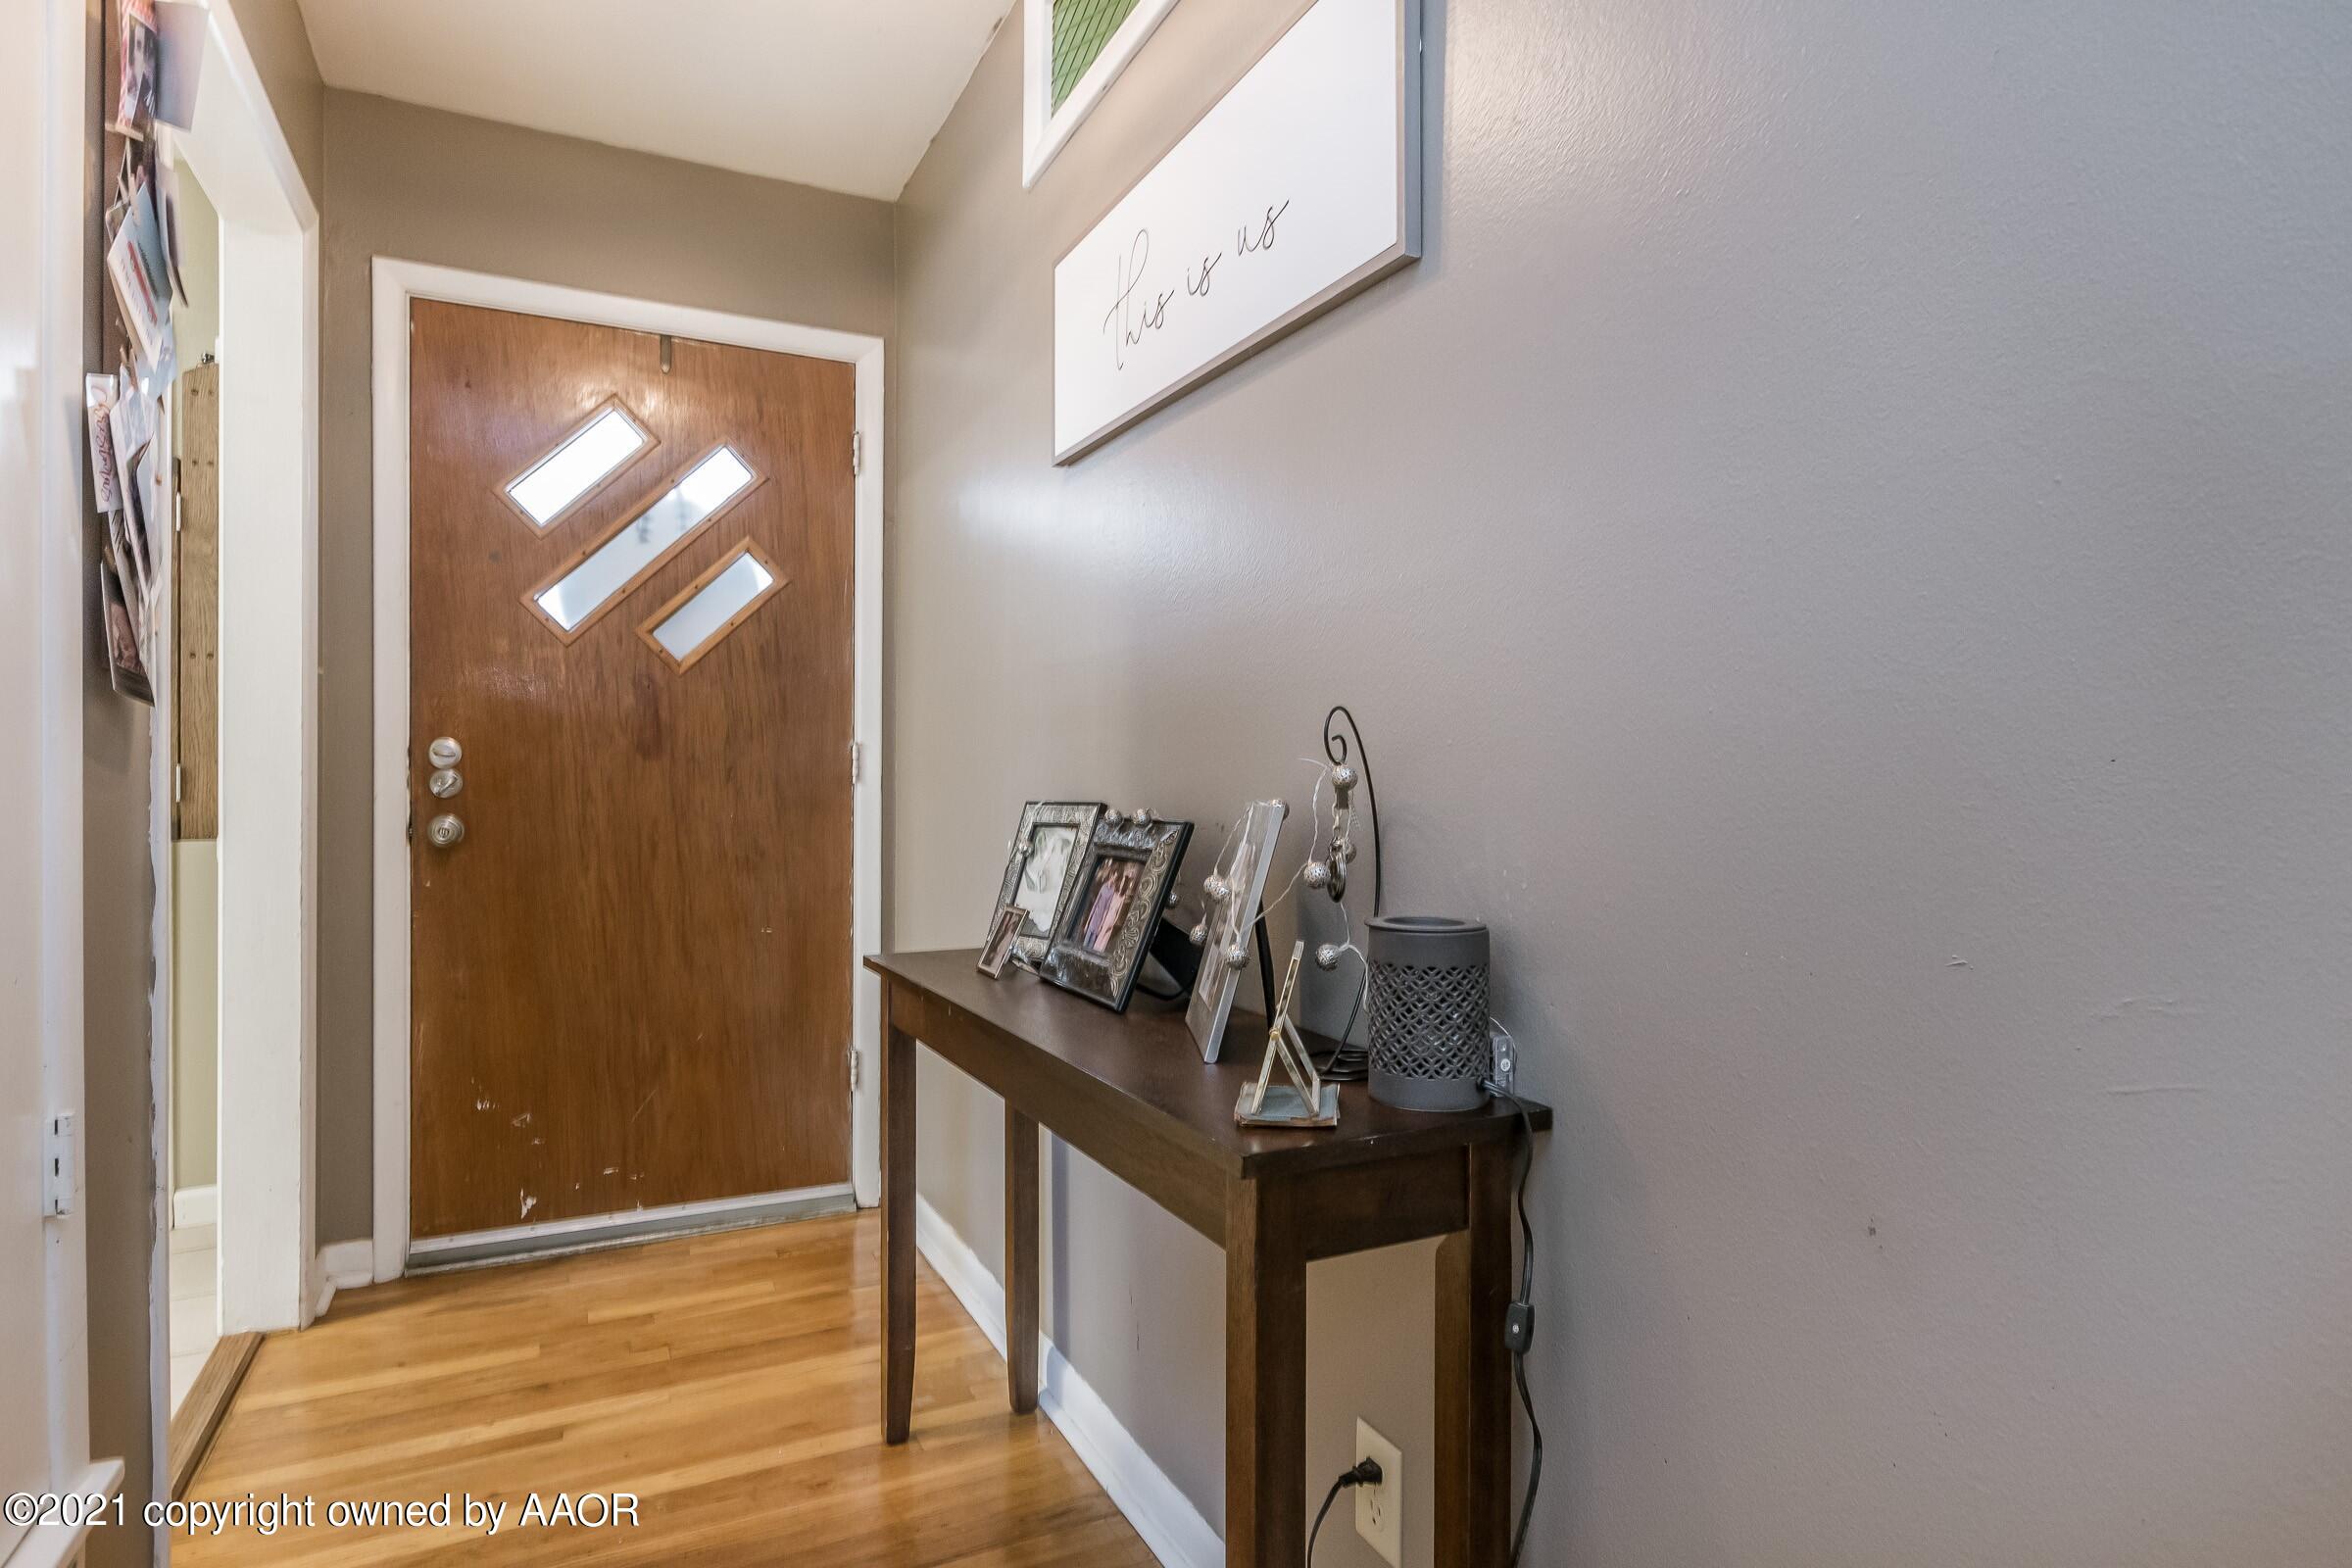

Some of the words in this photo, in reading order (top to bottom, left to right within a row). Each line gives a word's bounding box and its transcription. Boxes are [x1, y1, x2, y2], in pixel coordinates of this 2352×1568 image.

[1102, 228, 1174, 370] this
[1187, 252, 1222, 297] is
[1237, 199, 1290, 257] us
